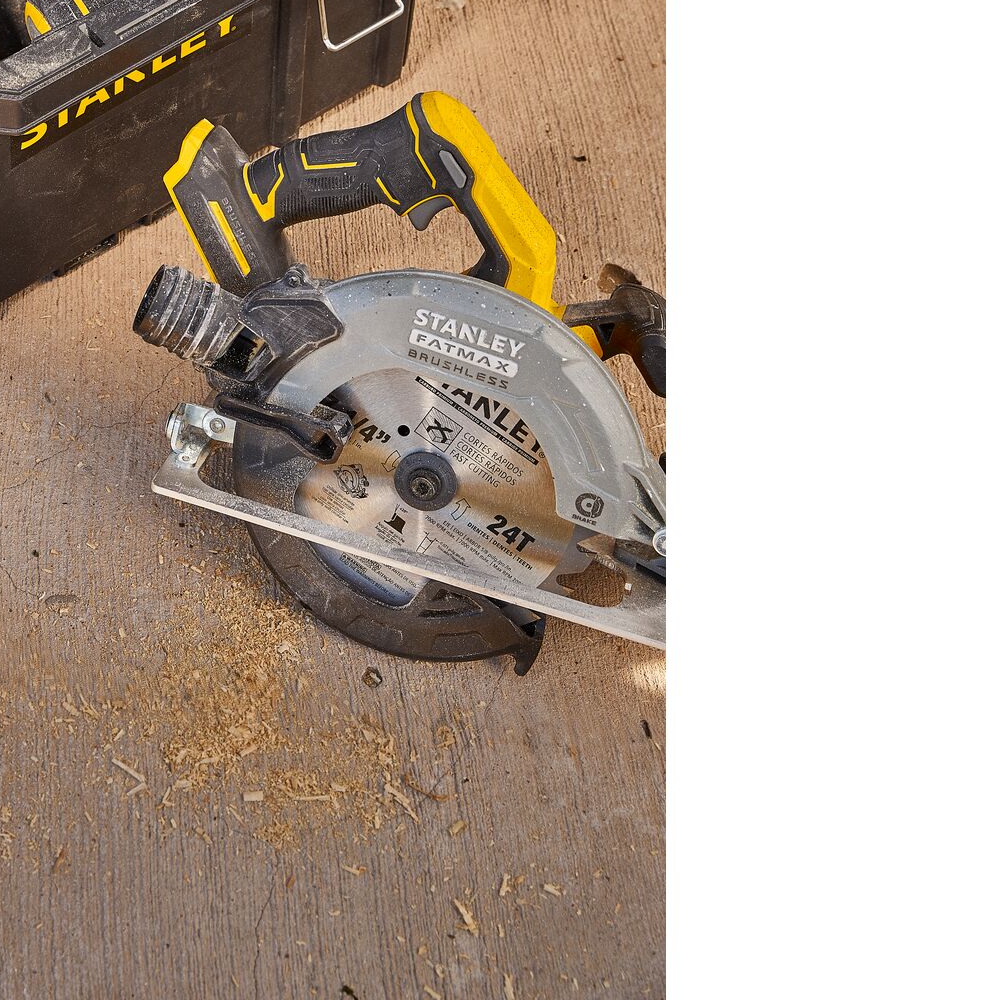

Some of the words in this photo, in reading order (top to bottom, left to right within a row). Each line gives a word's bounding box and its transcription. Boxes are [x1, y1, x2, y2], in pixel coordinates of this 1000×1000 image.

[413, 308, 525, 357] STANLEY
[416, 333, 509, 373] FATMAX
[408, 348, 508, 389] BRUSHLESS
[448, 449, 468, 465] FAST
[466, 461, 501, 488] CUTTING
[455, 440, 485, 463] CORTES
[483, 459, 518, 486] RÁPIDOS
[462, 431, 492, 454] CORTES
[490, 450, 525, 477] RÁPIDOS
[486, 514, 536, 552] 24T
[572, 514, 597, 526] BRAKE
[467, 522, 489, 540] DIENTES
[492, 540, 513, 556] DENTES
[516, 556, 533, 570] TEETH
